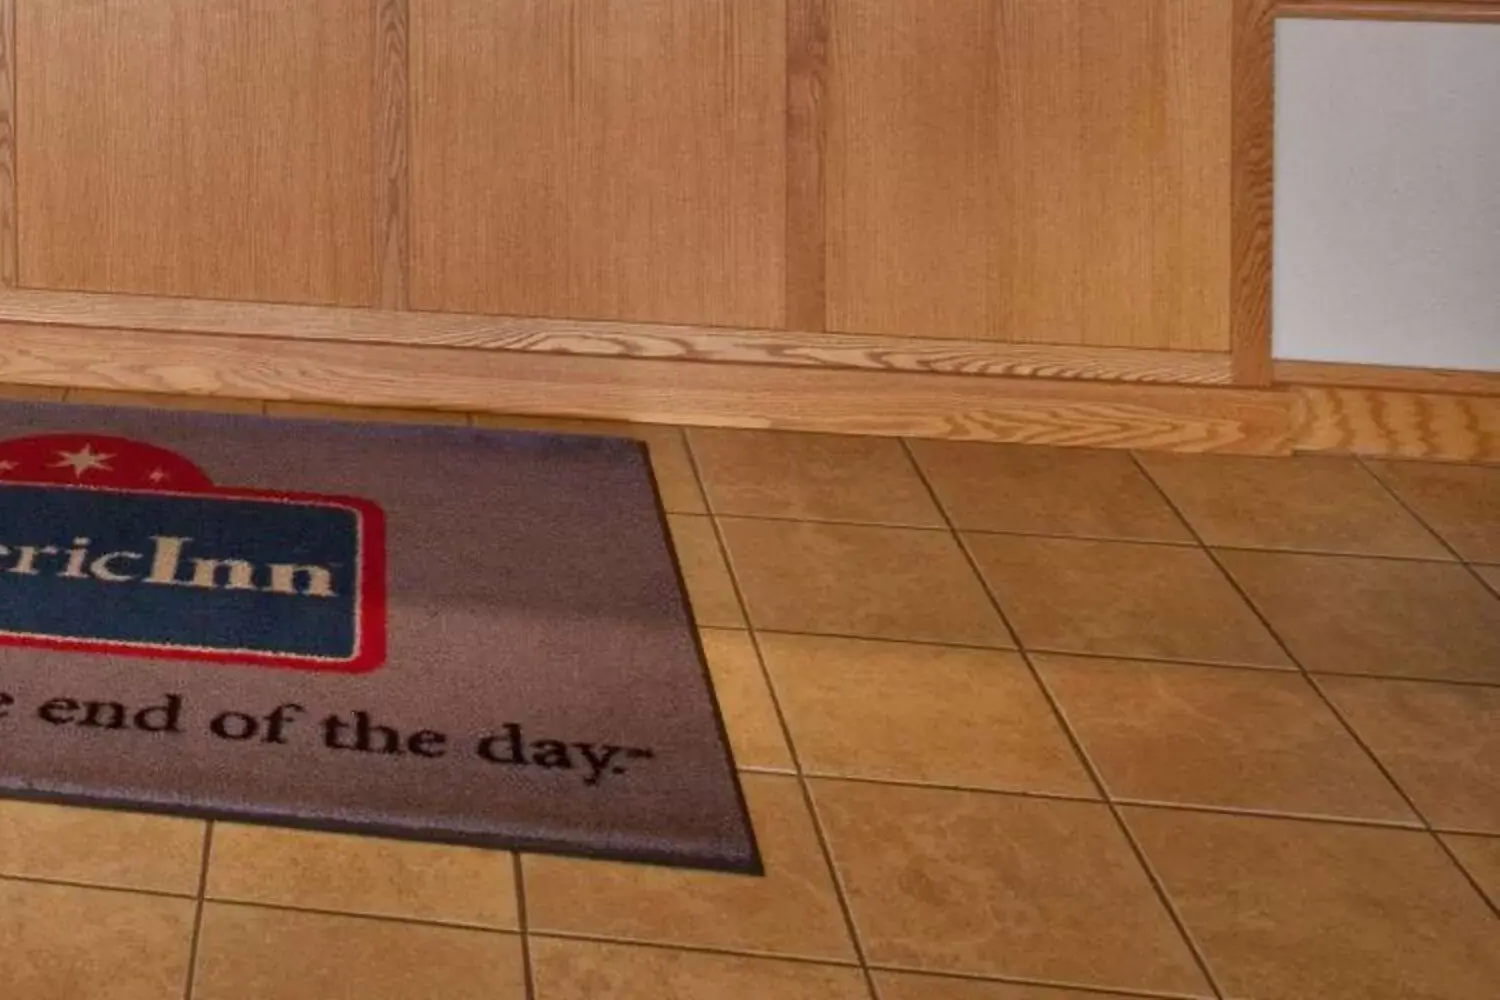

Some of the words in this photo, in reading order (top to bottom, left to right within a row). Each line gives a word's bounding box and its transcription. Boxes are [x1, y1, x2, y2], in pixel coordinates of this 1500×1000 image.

[38, 693, 183, 734] end
[209, 703, 304, 744] of
[322, 710, 448, 758] the
